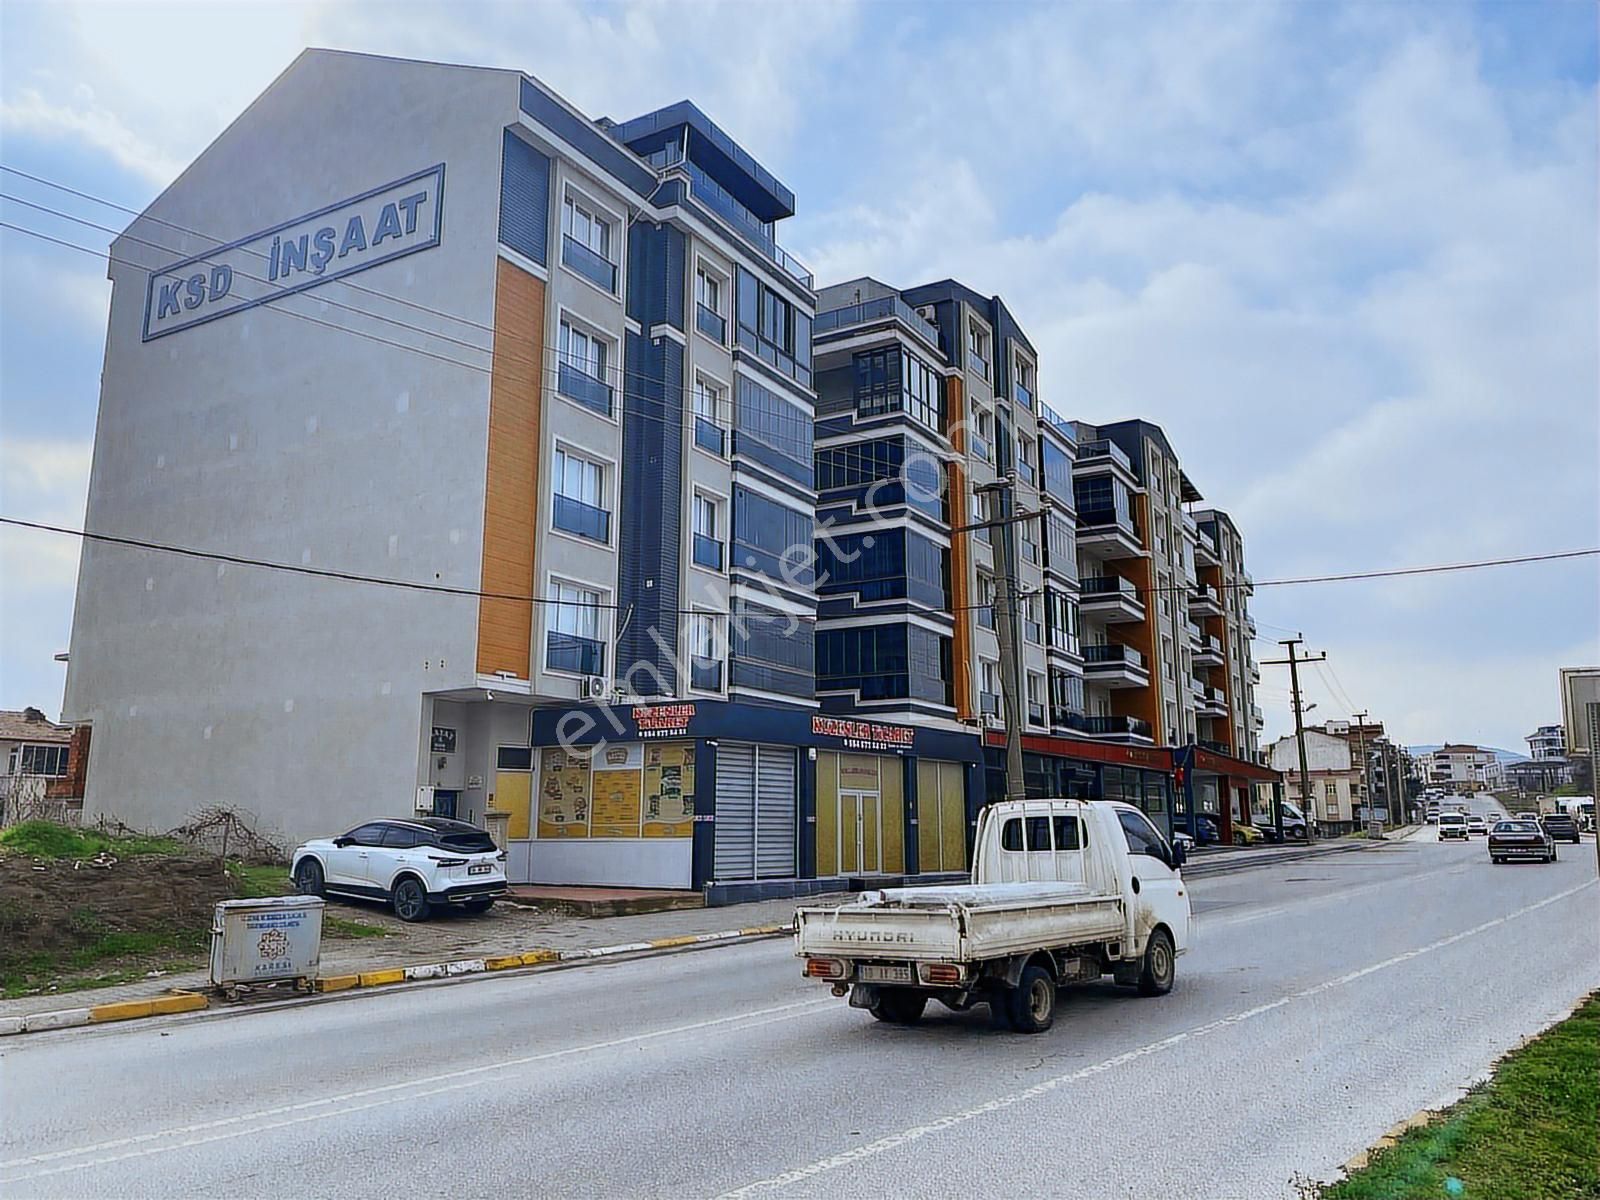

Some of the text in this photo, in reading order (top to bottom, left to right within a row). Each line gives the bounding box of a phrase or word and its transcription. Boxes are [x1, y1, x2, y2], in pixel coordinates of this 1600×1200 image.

[157, 190, 428, 320] KSD İNŞAAT
[832, 930, 915, 943] HYUNDAI
